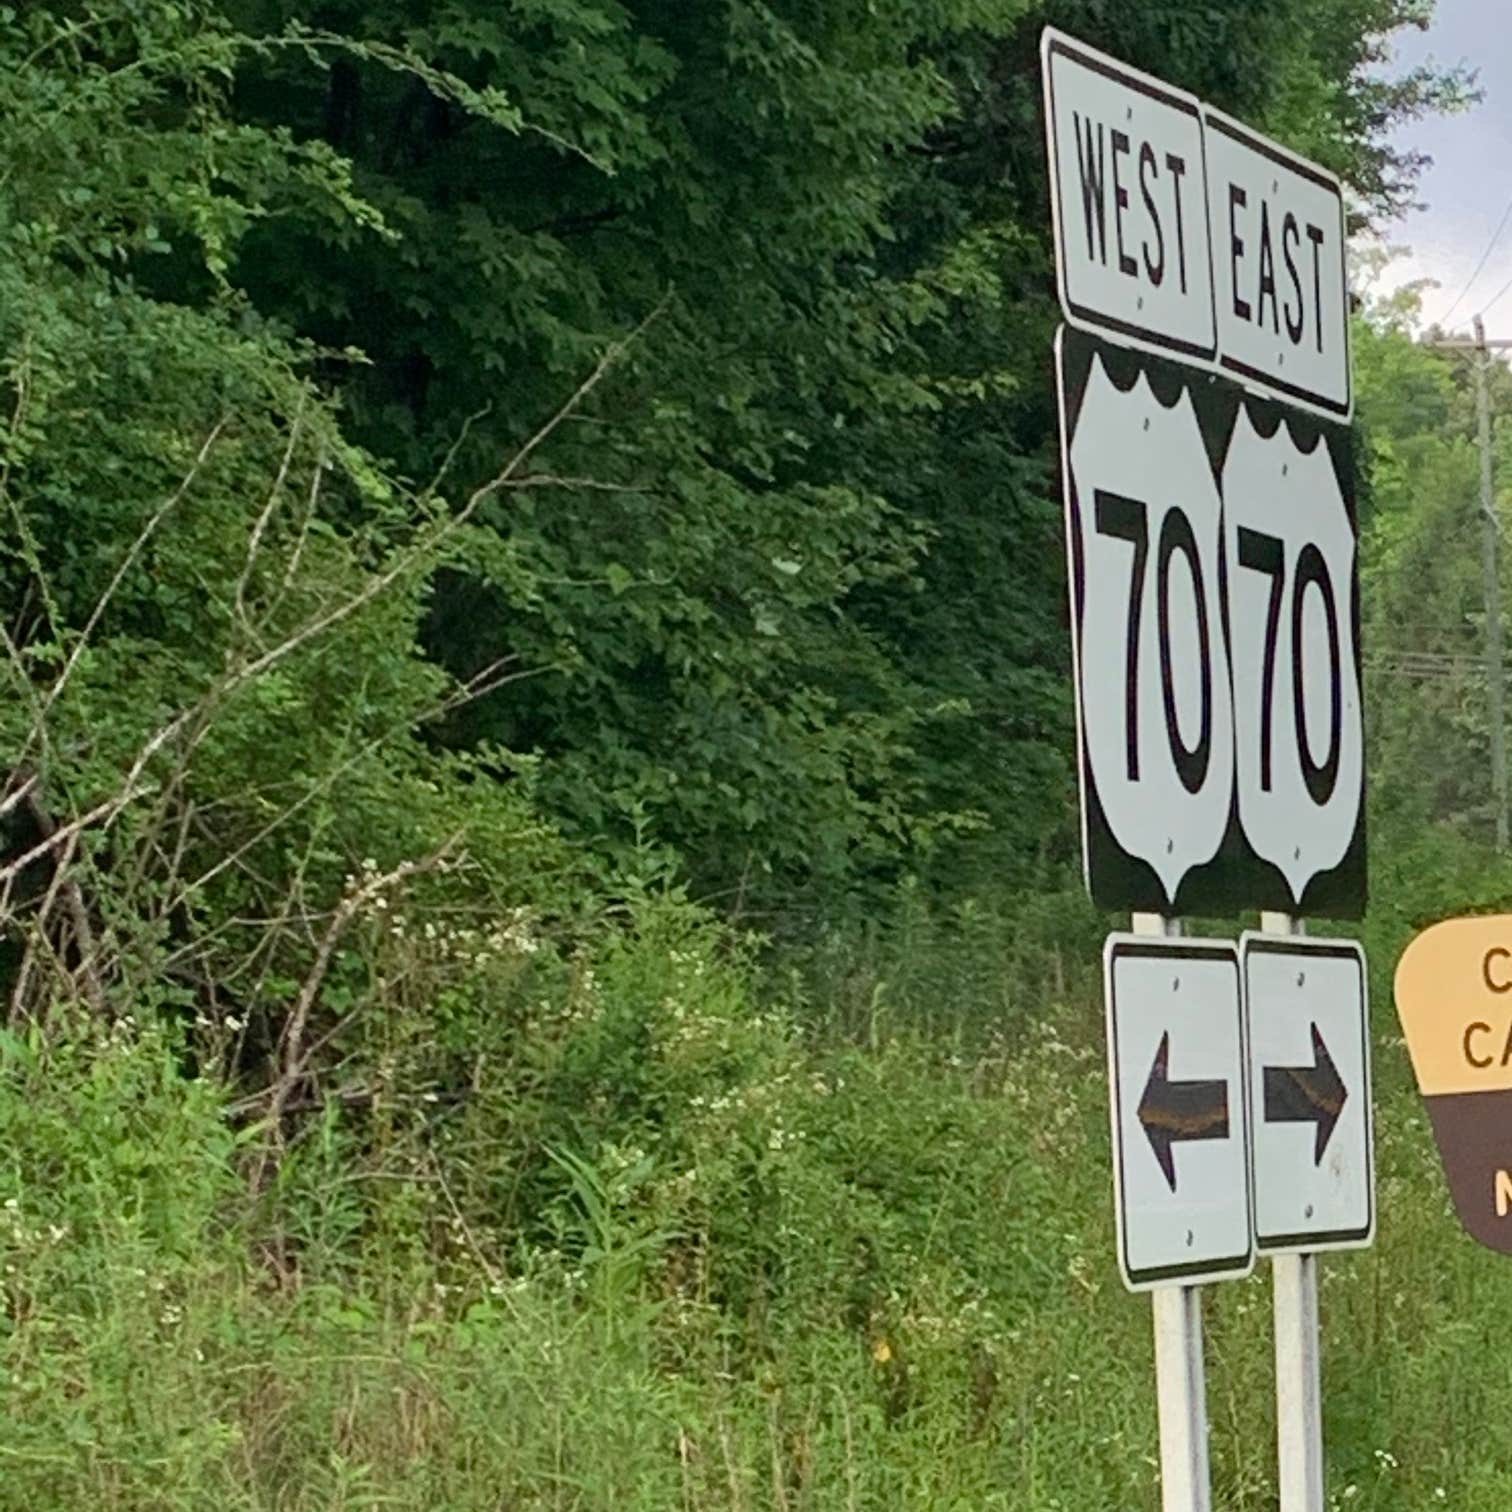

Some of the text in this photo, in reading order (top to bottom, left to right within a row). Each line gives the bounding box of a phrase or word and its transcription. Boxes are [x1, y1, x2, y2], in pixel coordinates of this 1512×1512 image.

[1073, 111, 1187, 294] WEST
[1229, 182, 1323, 353] EAST
[1093, 487, 1212, 794] 70
[1237, 525, 1341, 806] 70
